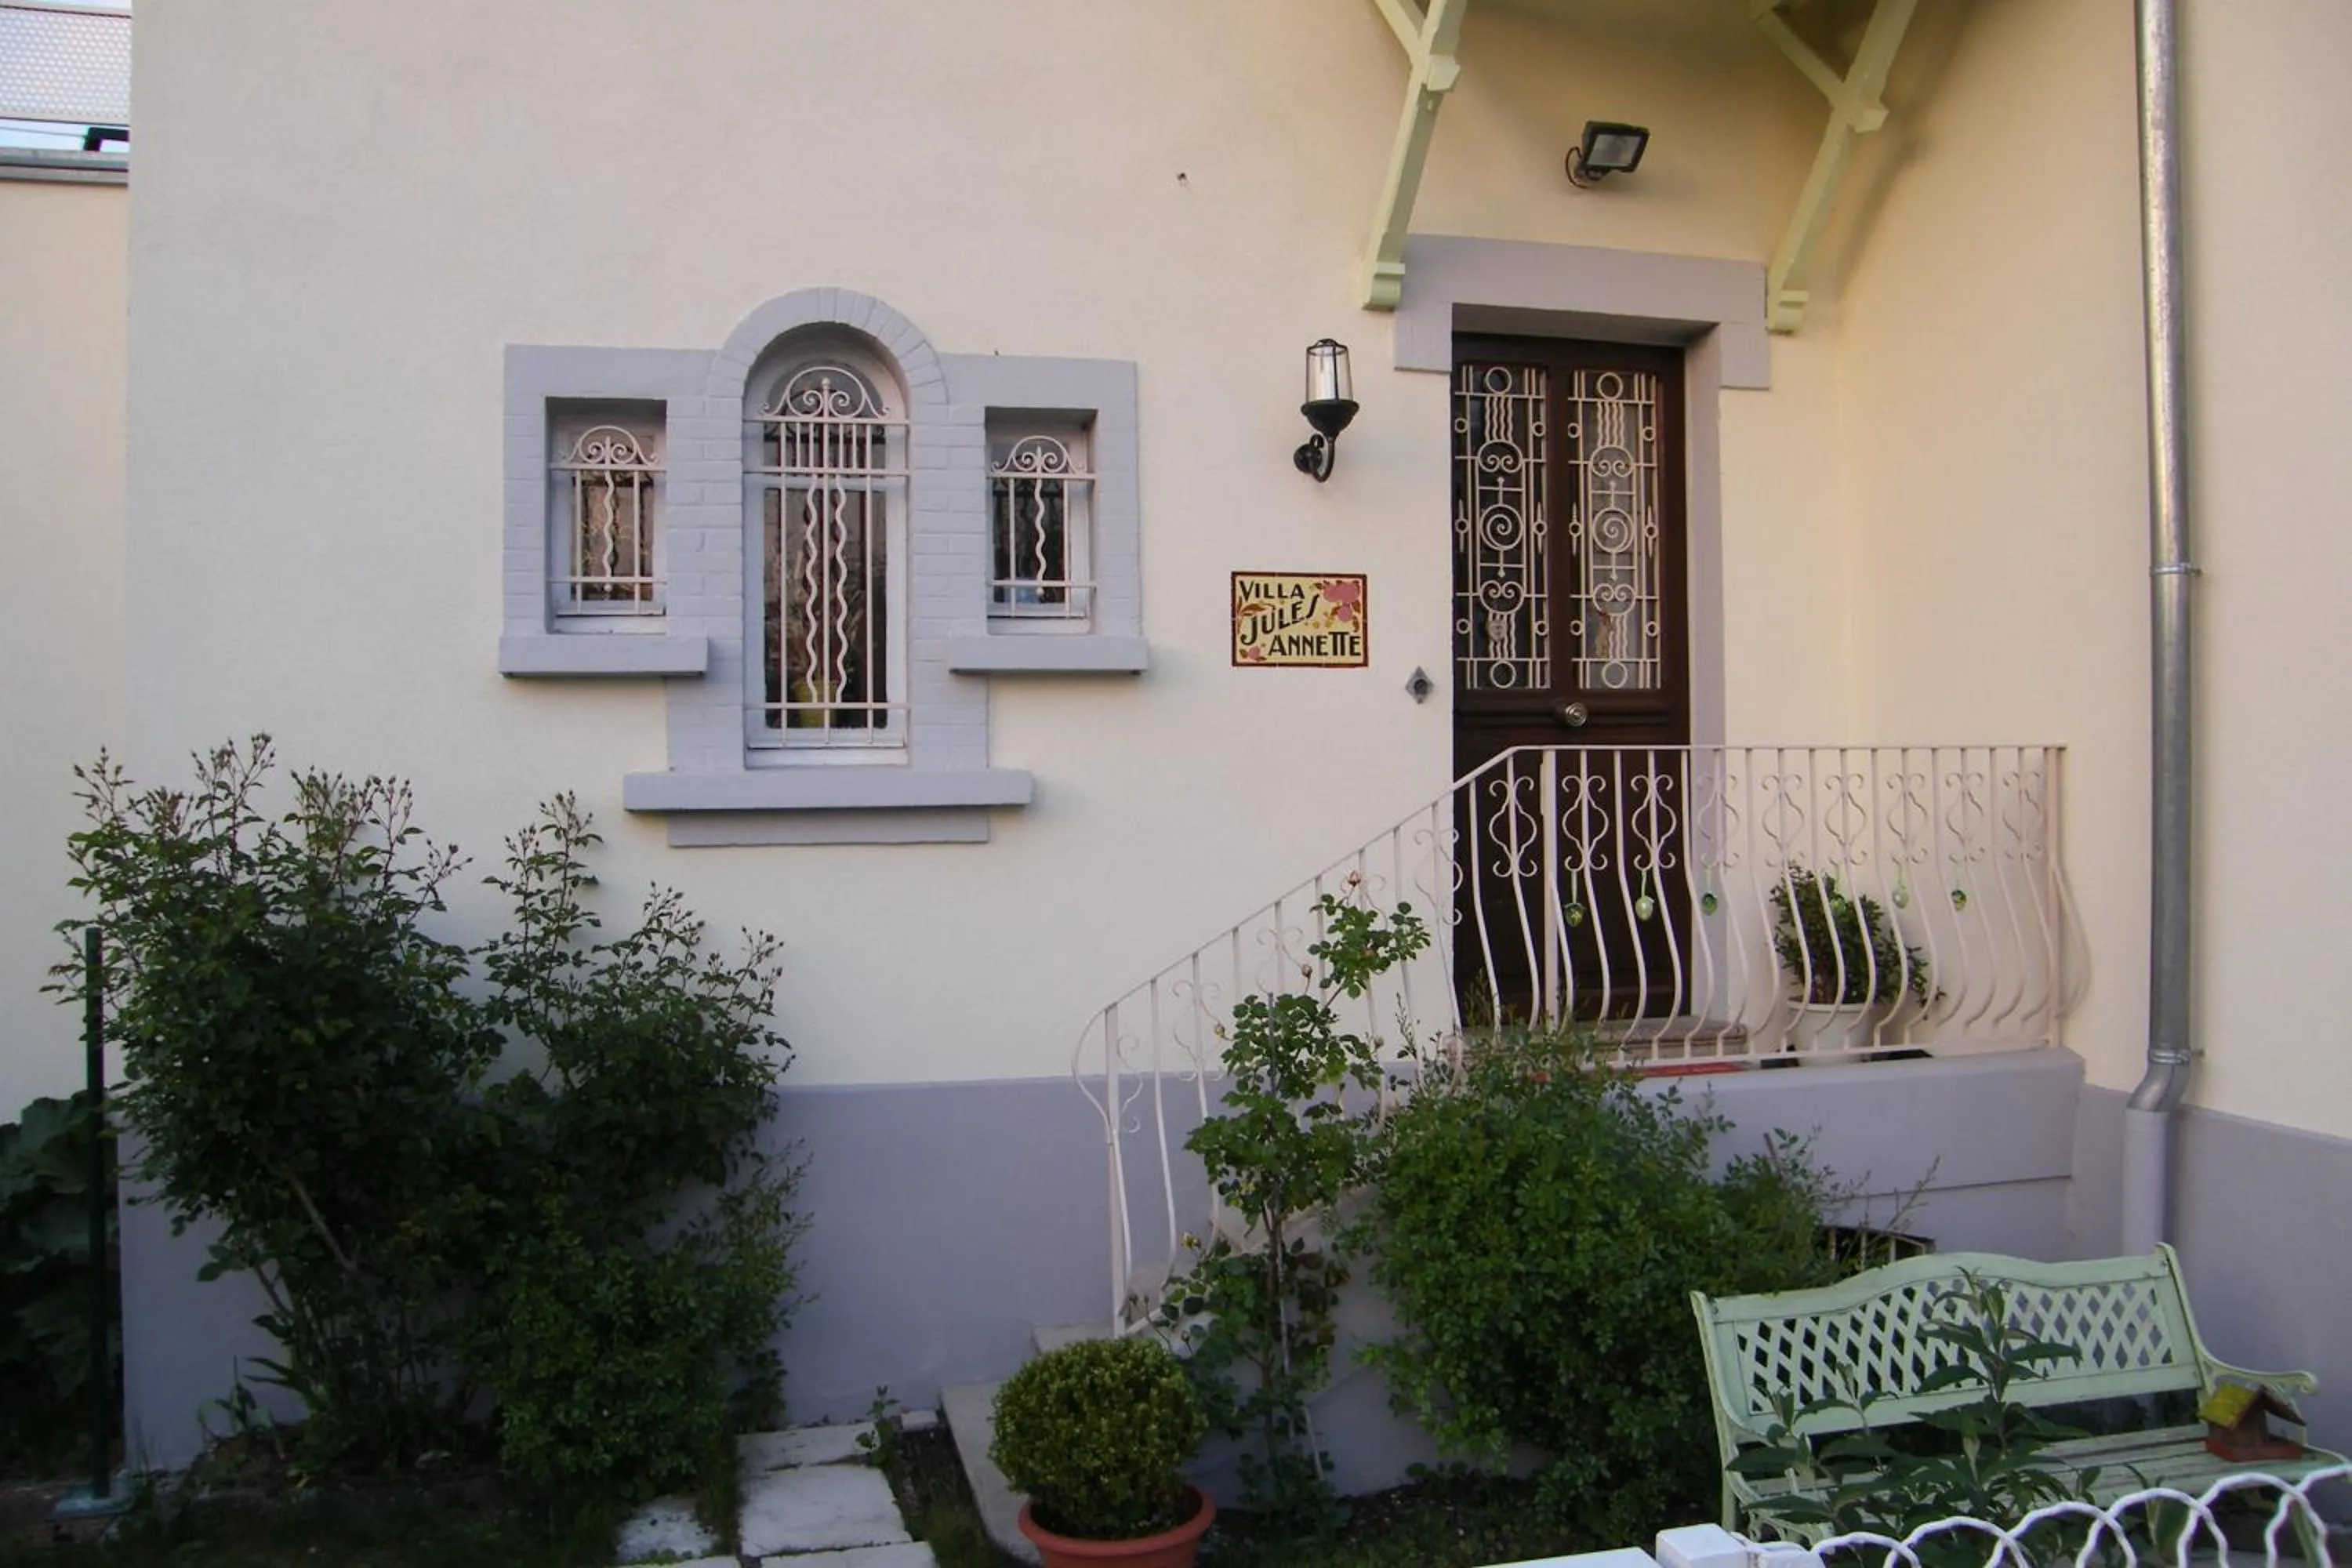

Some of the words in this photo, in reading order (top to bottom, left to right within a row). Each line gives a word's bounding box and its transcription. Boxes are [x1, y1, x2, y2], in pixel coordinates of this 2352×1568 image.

[1240, 580, 1305, 601] VILLA
[1240, 593, 1319, 645] JULES
[1268, 632, 1361, 656] ANNETTE
